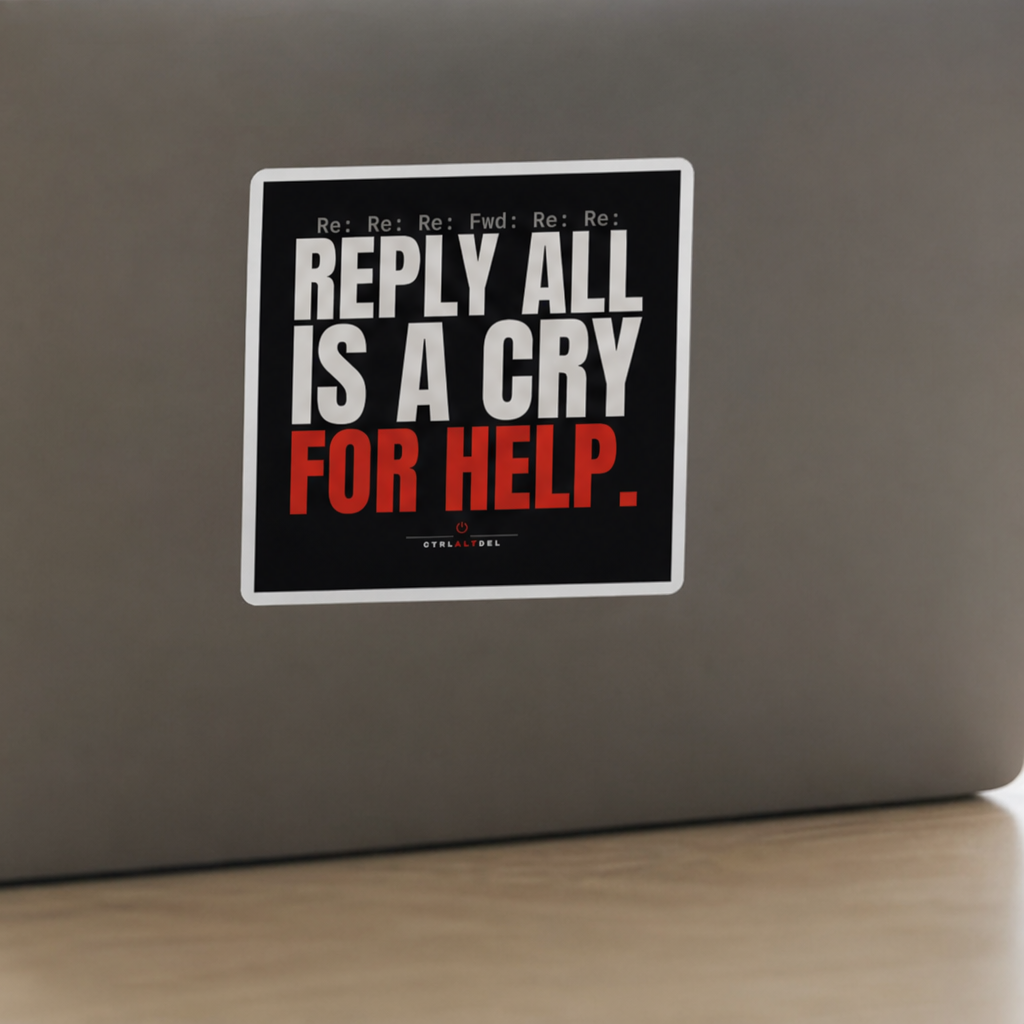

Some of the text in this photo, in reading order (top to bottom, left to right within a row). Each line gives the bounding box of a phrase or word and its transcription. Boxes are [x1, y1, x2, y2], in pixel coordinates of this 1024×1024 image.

[317, 210, 618, 234] Re: Re: Re: Fwd: Re: Re:
[294, 229, 643, 320] REPLY ALL
[291, 317, 642, 425] IS A CRY
[290, 423, 637, 515] FOR HELP.
